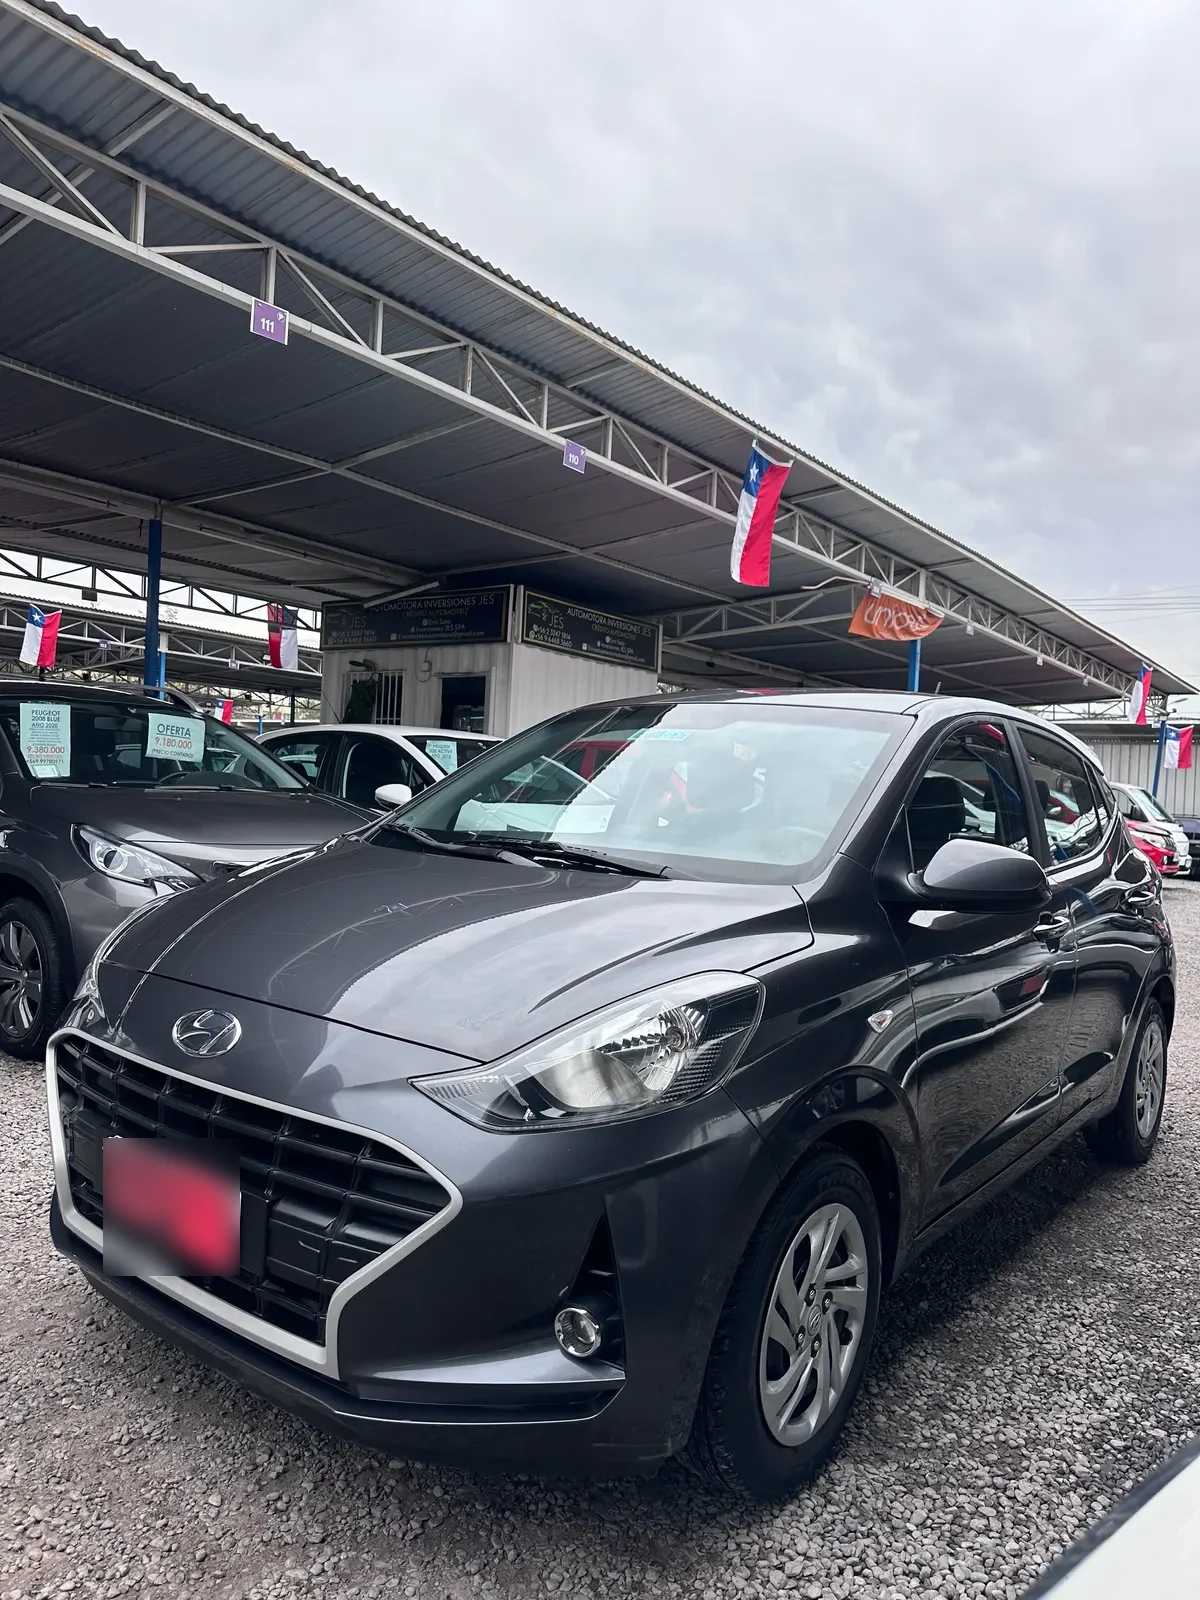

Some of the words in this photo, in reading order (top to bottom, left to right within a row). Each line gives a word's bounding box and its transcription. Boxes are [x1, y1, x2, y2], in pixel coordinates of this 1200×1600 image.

[261, 318, 275, 333] 111
[569, 453, 579, 465] 110
[370, 600, 422, 613] AUTOMOTORA
[424, 596, 476, 608] INVERSIONES
[478, 594, 495, 605] JES
[428, 608, 468, 616] AUTOMOTRIZ
[349, 615, 368, 628] JES
[549, 614, 564, 629] JES
[567, 608, 607, 625] AUTOMOTORA
[607, 619, 640, 634] INVERSIONES
[641, 627, 652, 637] JES
[157, 723, 191, 737] OFERTA
[155, 736, 192, 749] 9.180.000
[27, 746, 65, 754] 9.380.000
